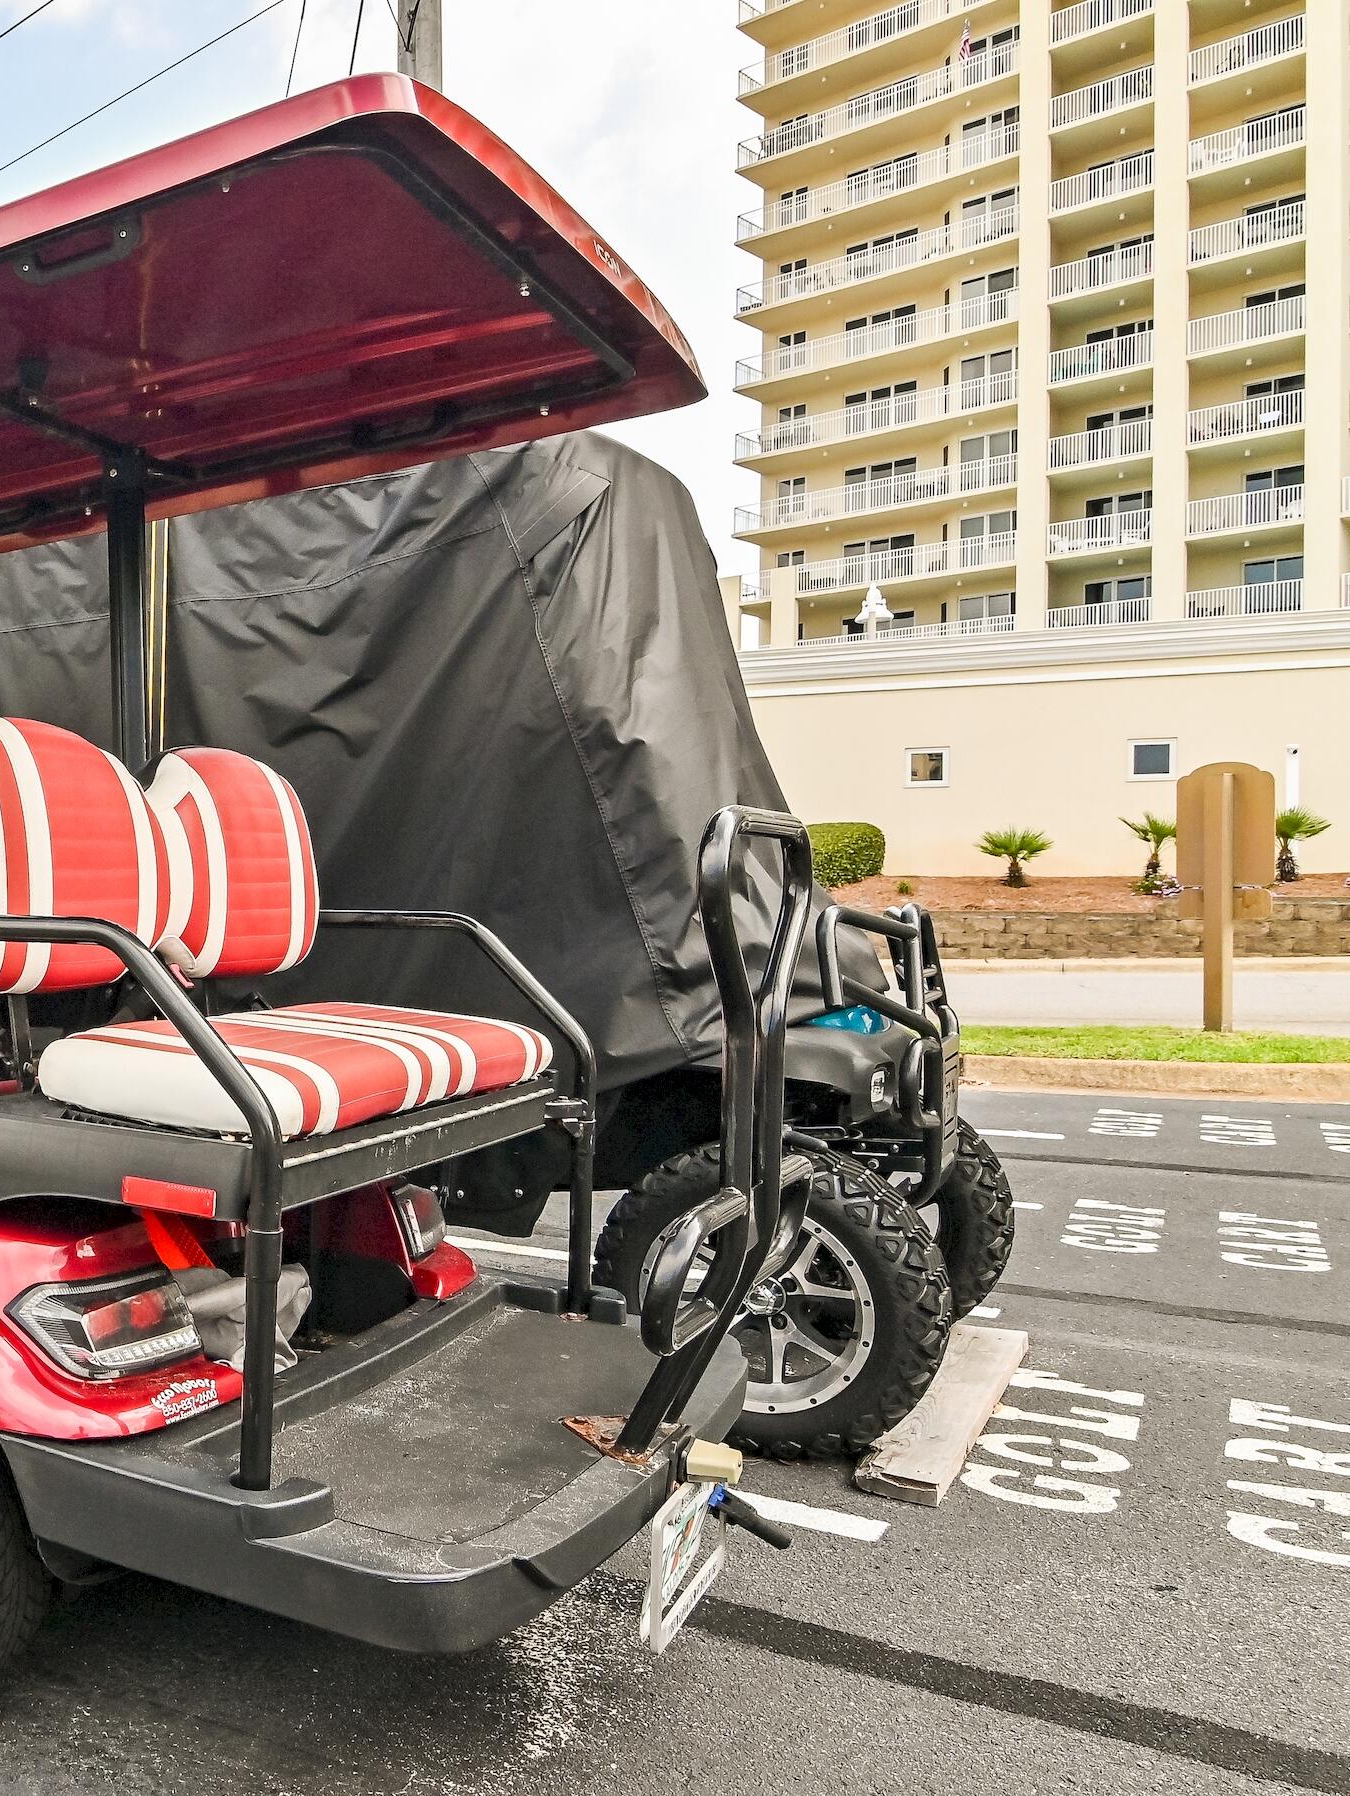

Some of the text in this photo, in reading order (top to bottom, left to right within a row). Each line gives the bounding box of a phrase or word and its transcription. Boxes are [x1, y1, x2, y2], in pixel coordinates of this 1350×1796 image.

[1087, 1108, 1164, 1137] GOLF
[1200, 1115, 1277, 1145] CART
[1060, 1198, 1166, 1254] GOLF
[1217, 1211, 1332, 1272] CART
[960, 1367, 1144, 1513] GOLF
[1224, 1398, 1350, 1566] CART
